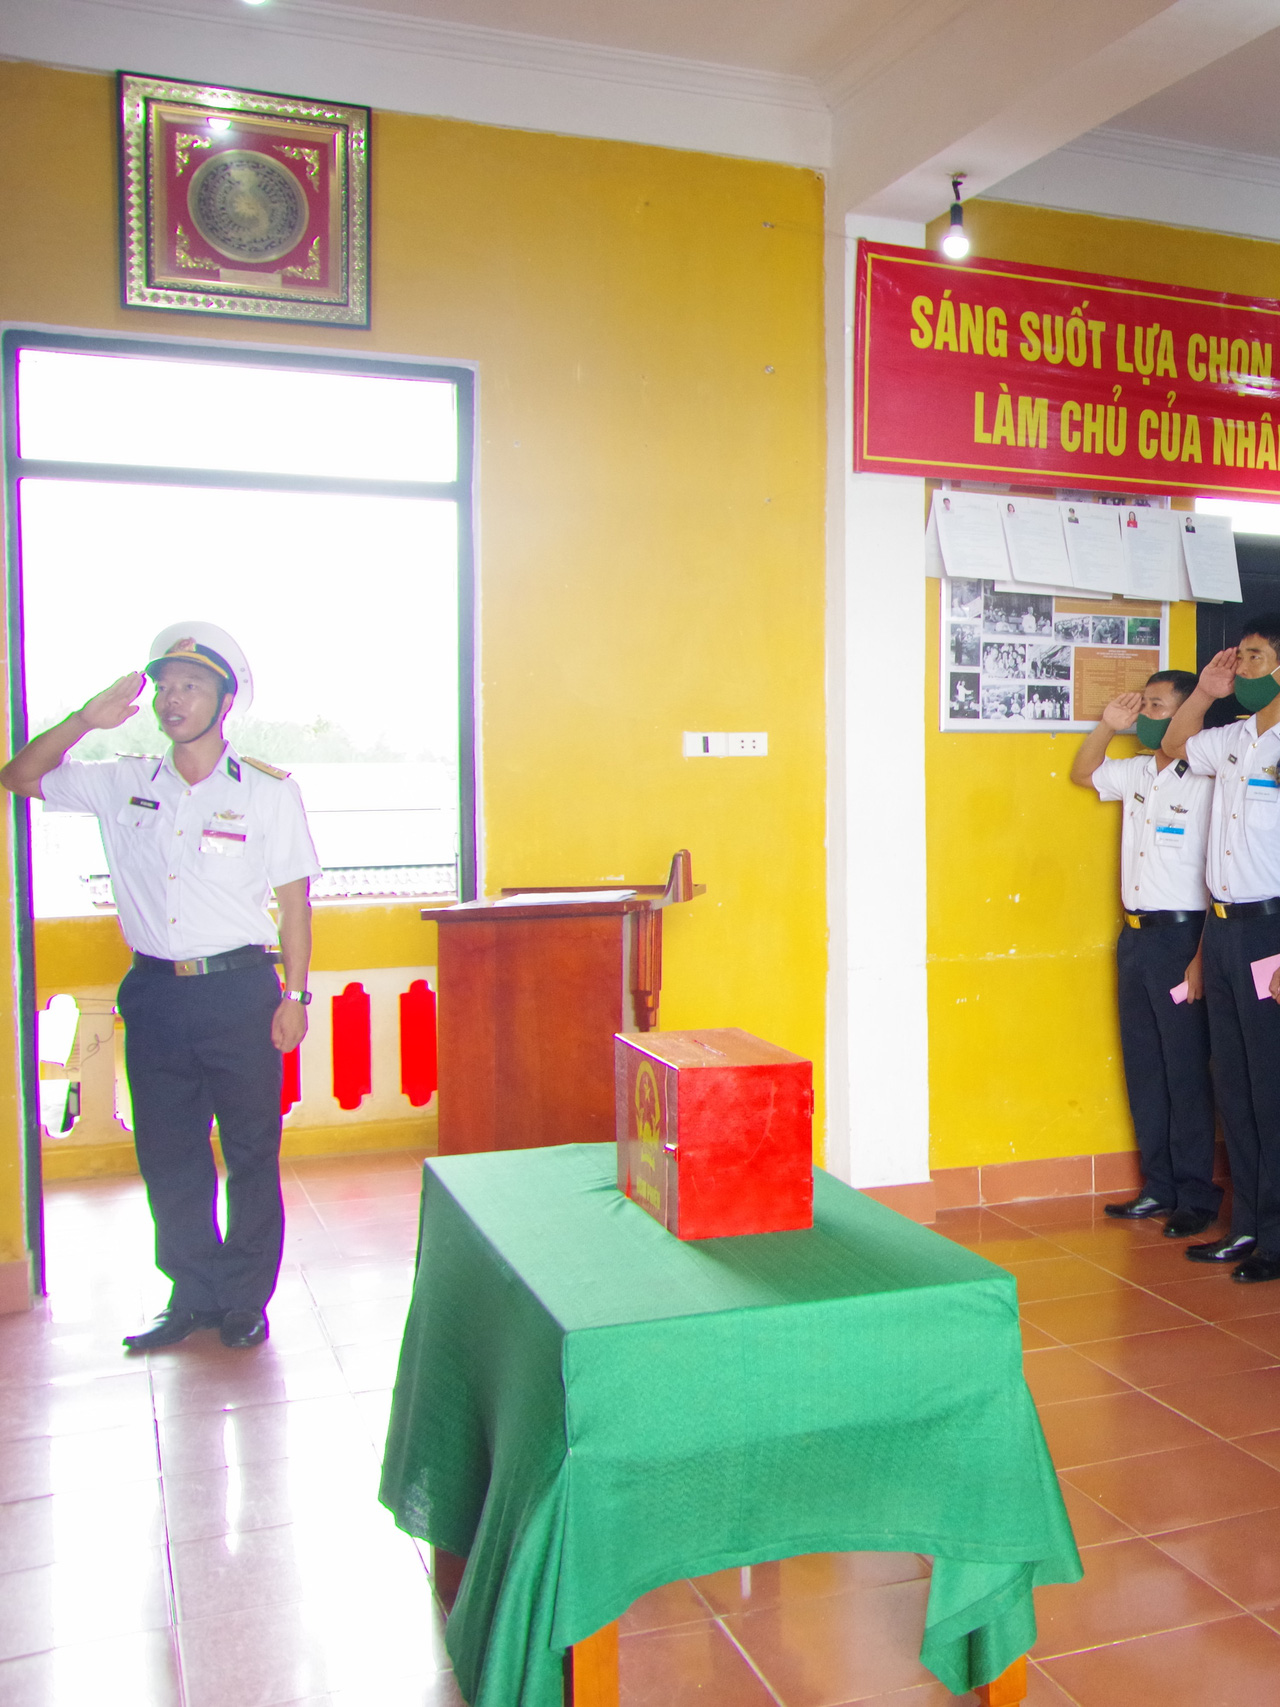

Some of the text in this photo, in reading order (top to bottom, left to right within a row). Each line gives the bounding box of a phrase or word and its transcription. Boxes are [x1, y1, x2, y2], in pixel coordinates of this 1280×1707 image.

[910, 289, 1008, 358] SÁNG
[1019, 300, 1106, 370] SUỐT
[1116, 323, 1178, 386] LỰA
[1187, 333, 1273, 397] CHỌN
[973, 382, 1048, 449] LÀM
[1060, 384, 1128, 457] CHỦ
[1138, 390, 1203, 464] CỦA
